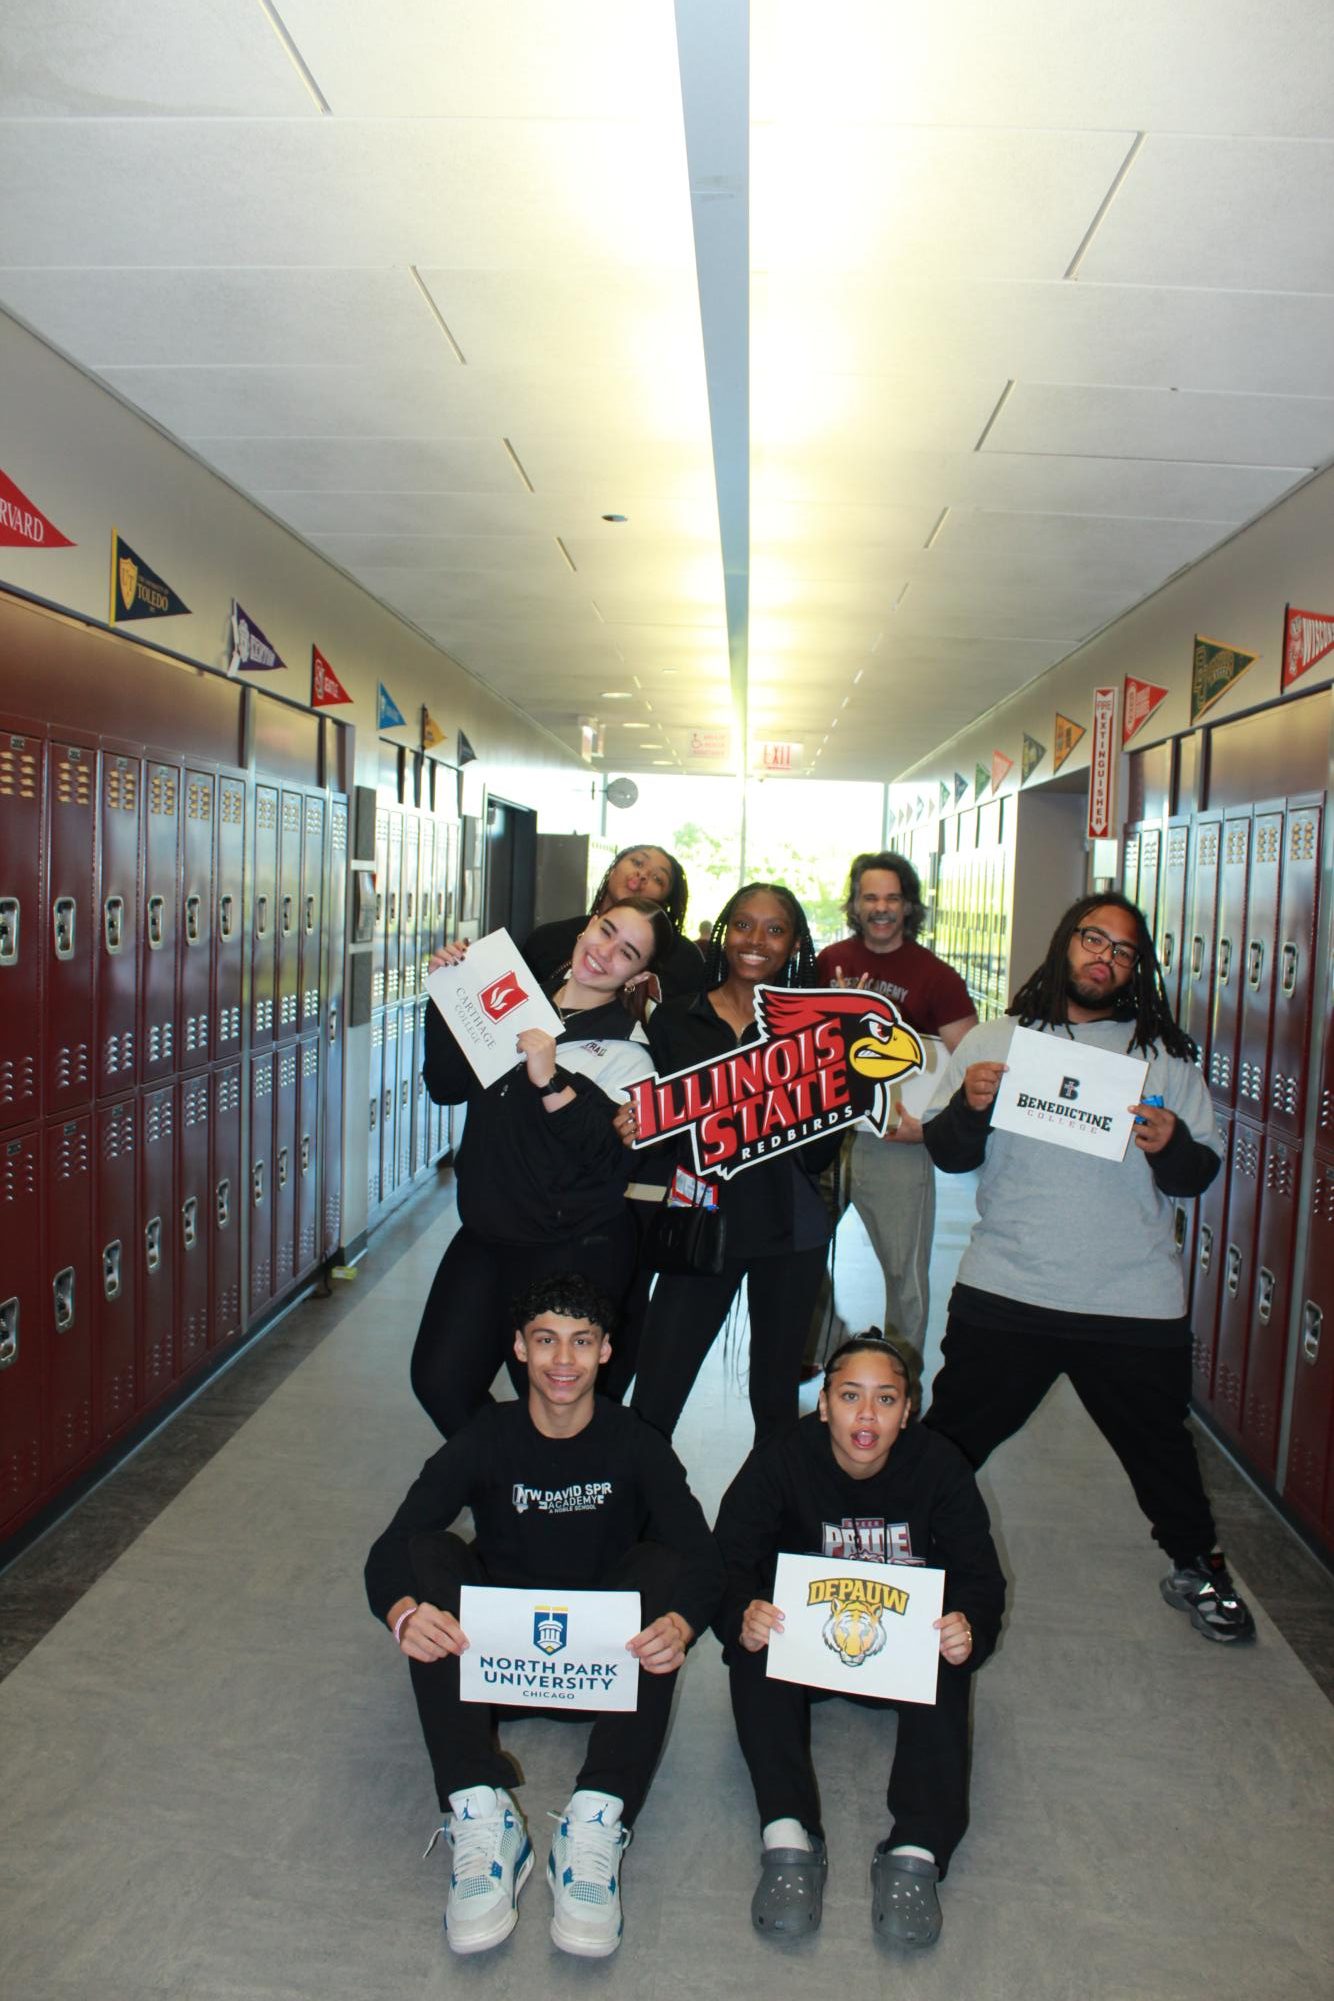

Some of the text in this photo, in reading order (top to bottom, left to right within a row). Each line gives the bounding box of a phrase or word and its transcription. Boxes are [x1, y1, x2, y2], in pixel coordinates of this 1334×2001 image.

[138, 583, 168, 611] TOLEDO
[1095, 711, 1106, 826] EXTINGUISHER
[454, 1004, 482, 1044] COLLEGE
[456, 986, 497, 1050] CARTHAGE
[632, 1017, 846, 1140] ILLINOIS
[701, 1061, 850, 1166] STATE
[1017, 1093, 1113, 1132] BENEDICTINE
[1027, 1108, 1098, 1135] COLLEGE
[741, 1105, 854, 1160] REDBIRDS
[545, 1485, 582, 1502] DAVID
[548, 1495, 598, 1510] ACADEMY
[808, 1578, 910, 1615] DEPAUW
[480, 1656, 618, 1677] NORTH PARK
[484, 1670, 614, 1691] UNIVERSITY
[522, 1690, 576, 1700] CHICAGO
